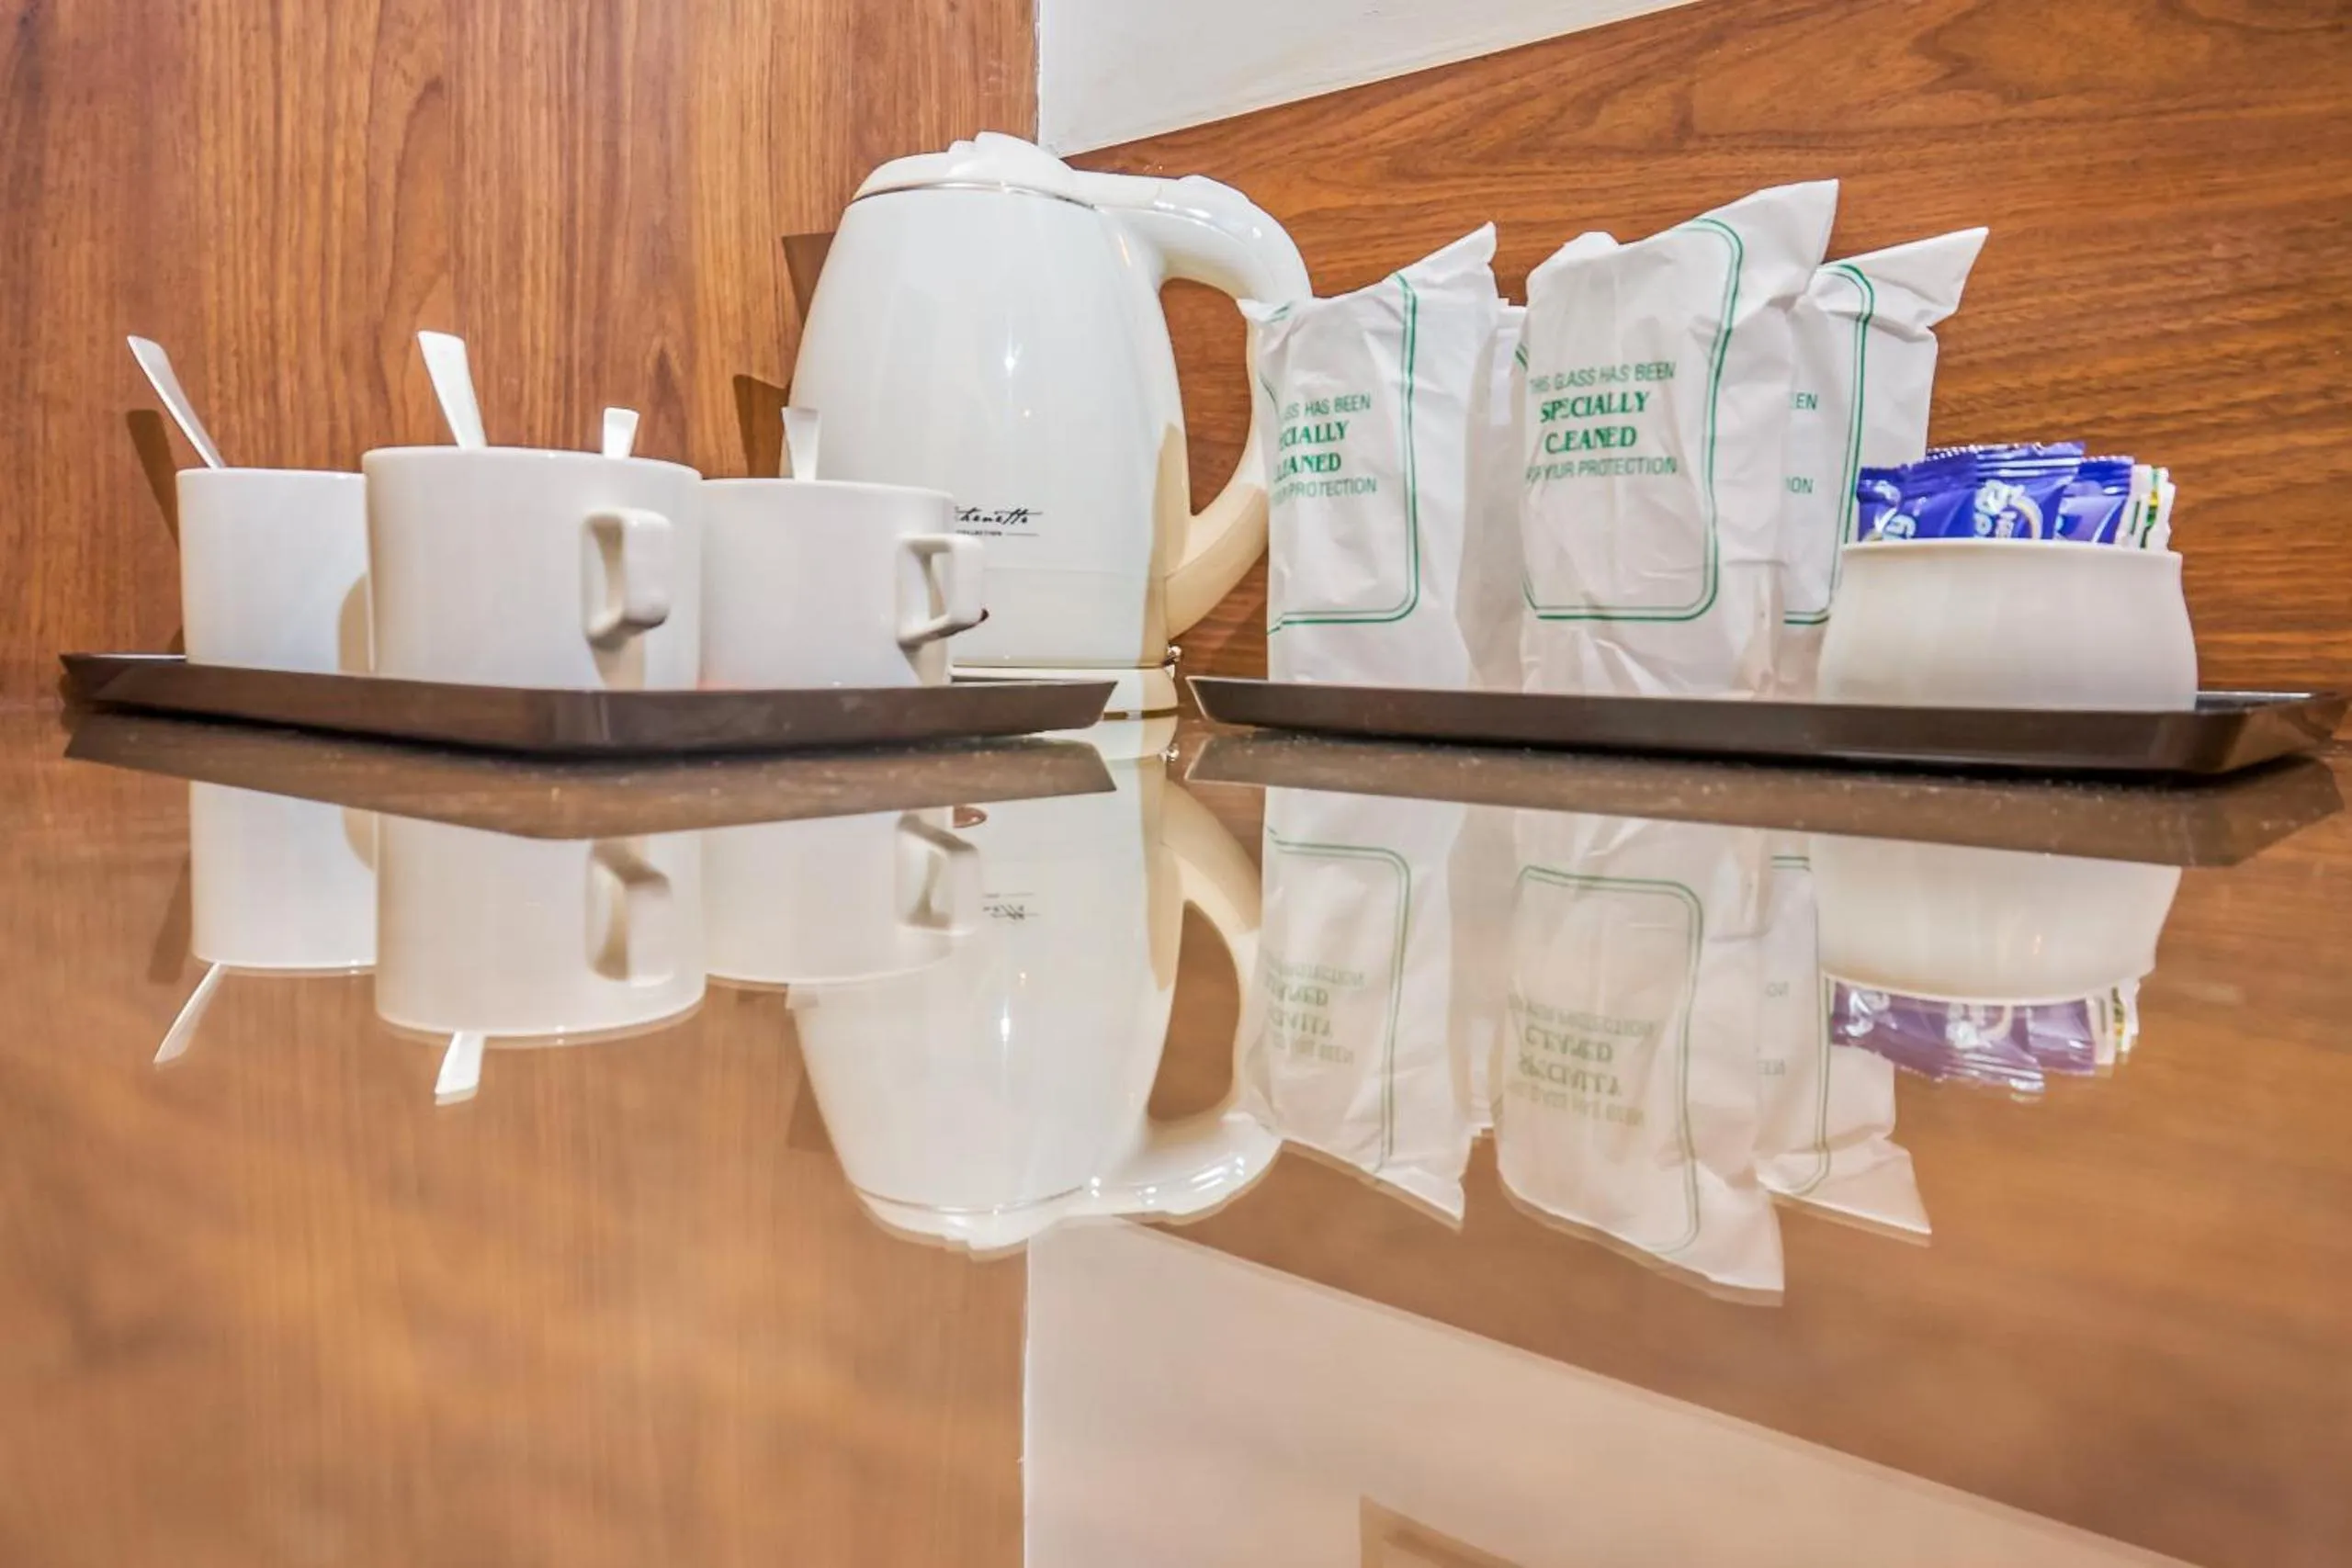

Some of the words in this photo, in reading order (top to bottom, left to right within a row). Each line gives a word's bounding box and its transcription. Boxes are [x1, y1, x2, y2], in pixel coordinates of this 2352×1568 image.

[1599, 364, 1630, 383] HAS
[1634, 361, 1676, 382] BEEN
[1305, 398, 1330, 417] HAS
[1334, 393, 1372, 413] BEEN
[1577, 457, 1678, 477] PROTECTION
[1288, 477, 1377, 499] PROTECTION
